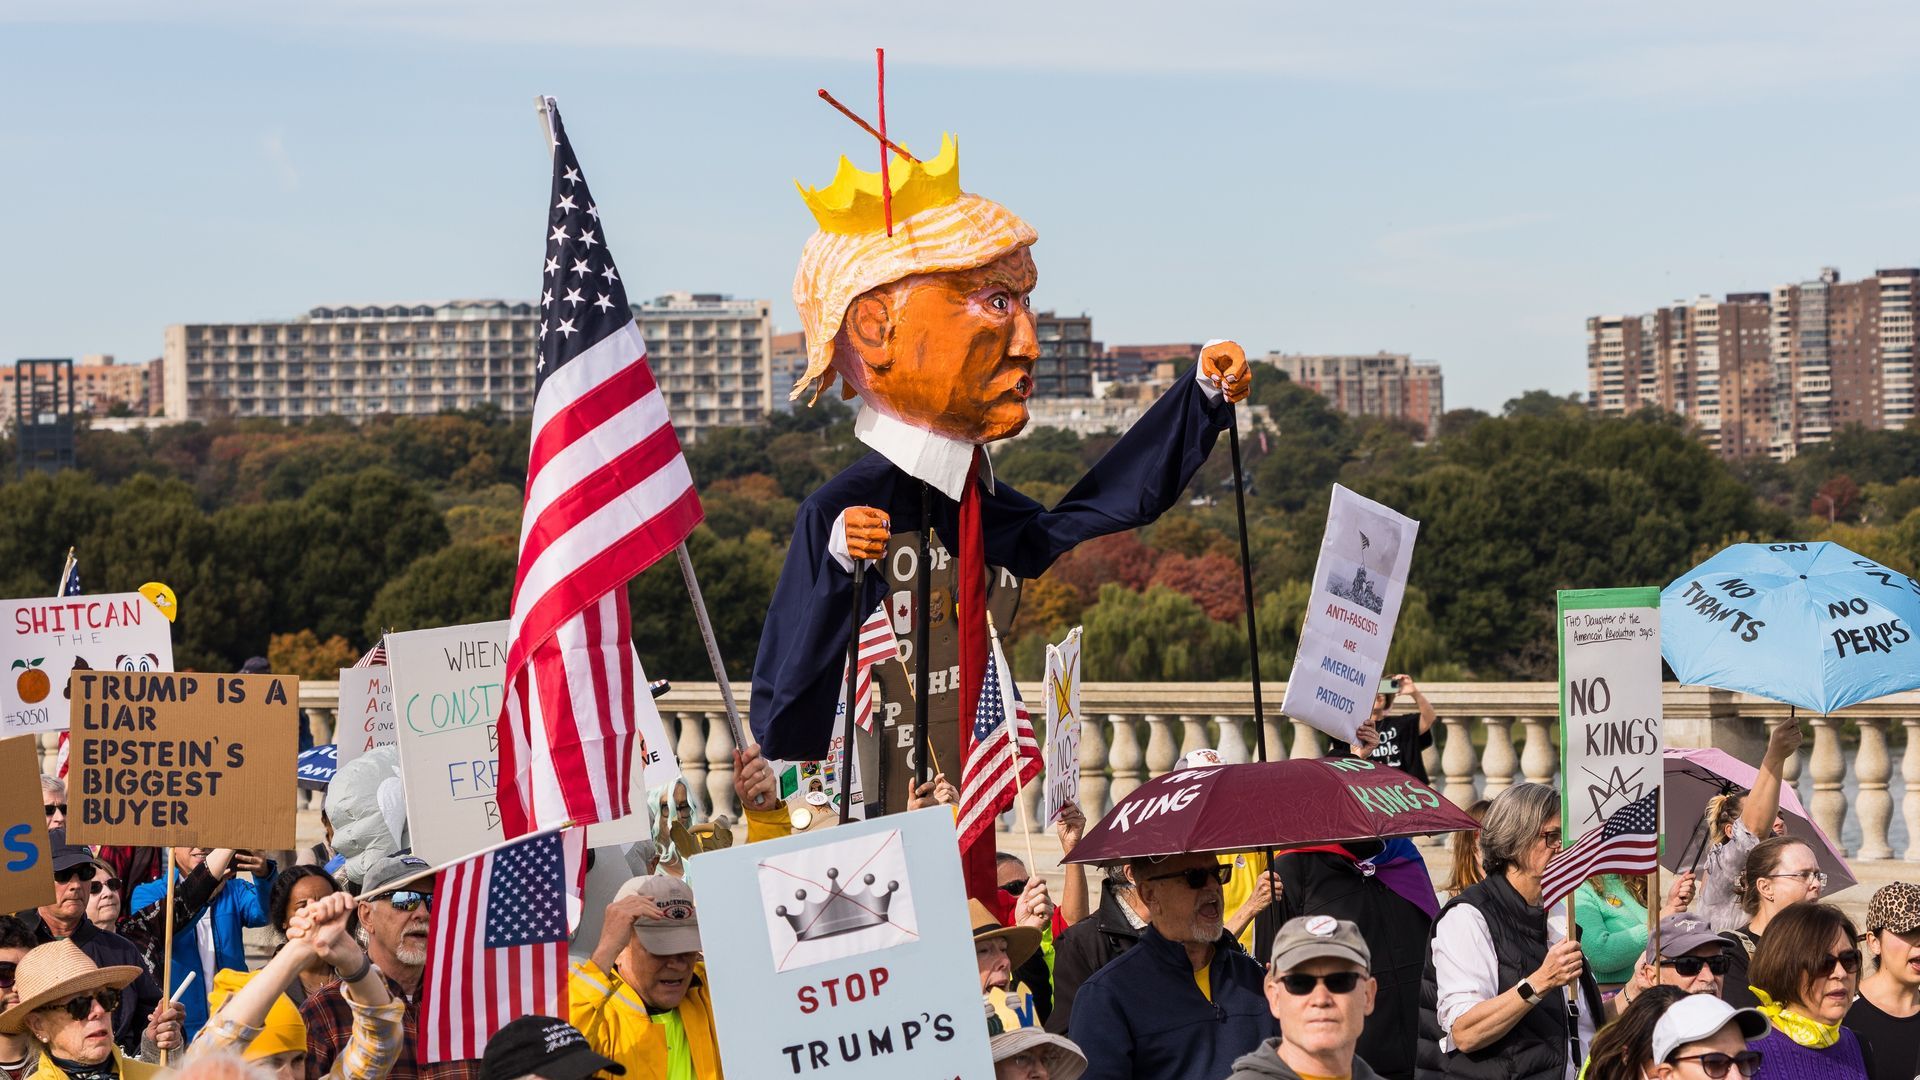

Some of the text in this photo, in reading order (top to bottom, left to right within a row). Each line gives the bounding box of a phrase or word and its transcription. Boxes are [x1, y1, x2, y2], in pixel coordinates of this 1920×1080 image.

[1716, 578, 1757, 599] NO
[15, 599, 142, 635] SHITCAN
[1325, 603, 1378, 636] ANTI-FASCISTS
[1584, 614, 1617, 632] Daughter
[1619, 612, 1627, 625] of
[1681, 580, 1766, 643] TYRANTS
[1828, 597, 1869, 619] NO
[53, 631, 103, 647] THE
[1343, 639, 1358, 653] ARE
[1573, 630, 1603, 642] American
[1605, 626, 1636, 640] Revolution
[1830, 618, 1910, 659] PERPS
[443, 640, 508, 672] WHEN
[1320, 655, 1367, 688] AMERICAN
[80, 674, 288, 706] TRUMP IS A
[365, 697, 392, 714] Are
[1315, 685, 1355, 714] PATRIOTS
[1570, 677, 1611, 717] NO
[5, 706, 49, 728] #50501
[83, 704, 157, 731] LIAR
[83, 736, 245, 768] EPSTEIN'S
[1585, 717, 1659, 757] KINGS
[1057, 735, 1073, 777] NO
[1322, 757, 1376, 772] NO
[83, 768, 223, 797] BIGGEST
[1051, 768, 1077, 815] KINGS
[83, 798, 190, 827] BUYER
[1108, 783, 1203, 833] KING
[1347, 780, 1440, 818] KINGS
[796, 966, 890, 1015] STOP
[782, 1012, 955, 1074] TRUMP'S
